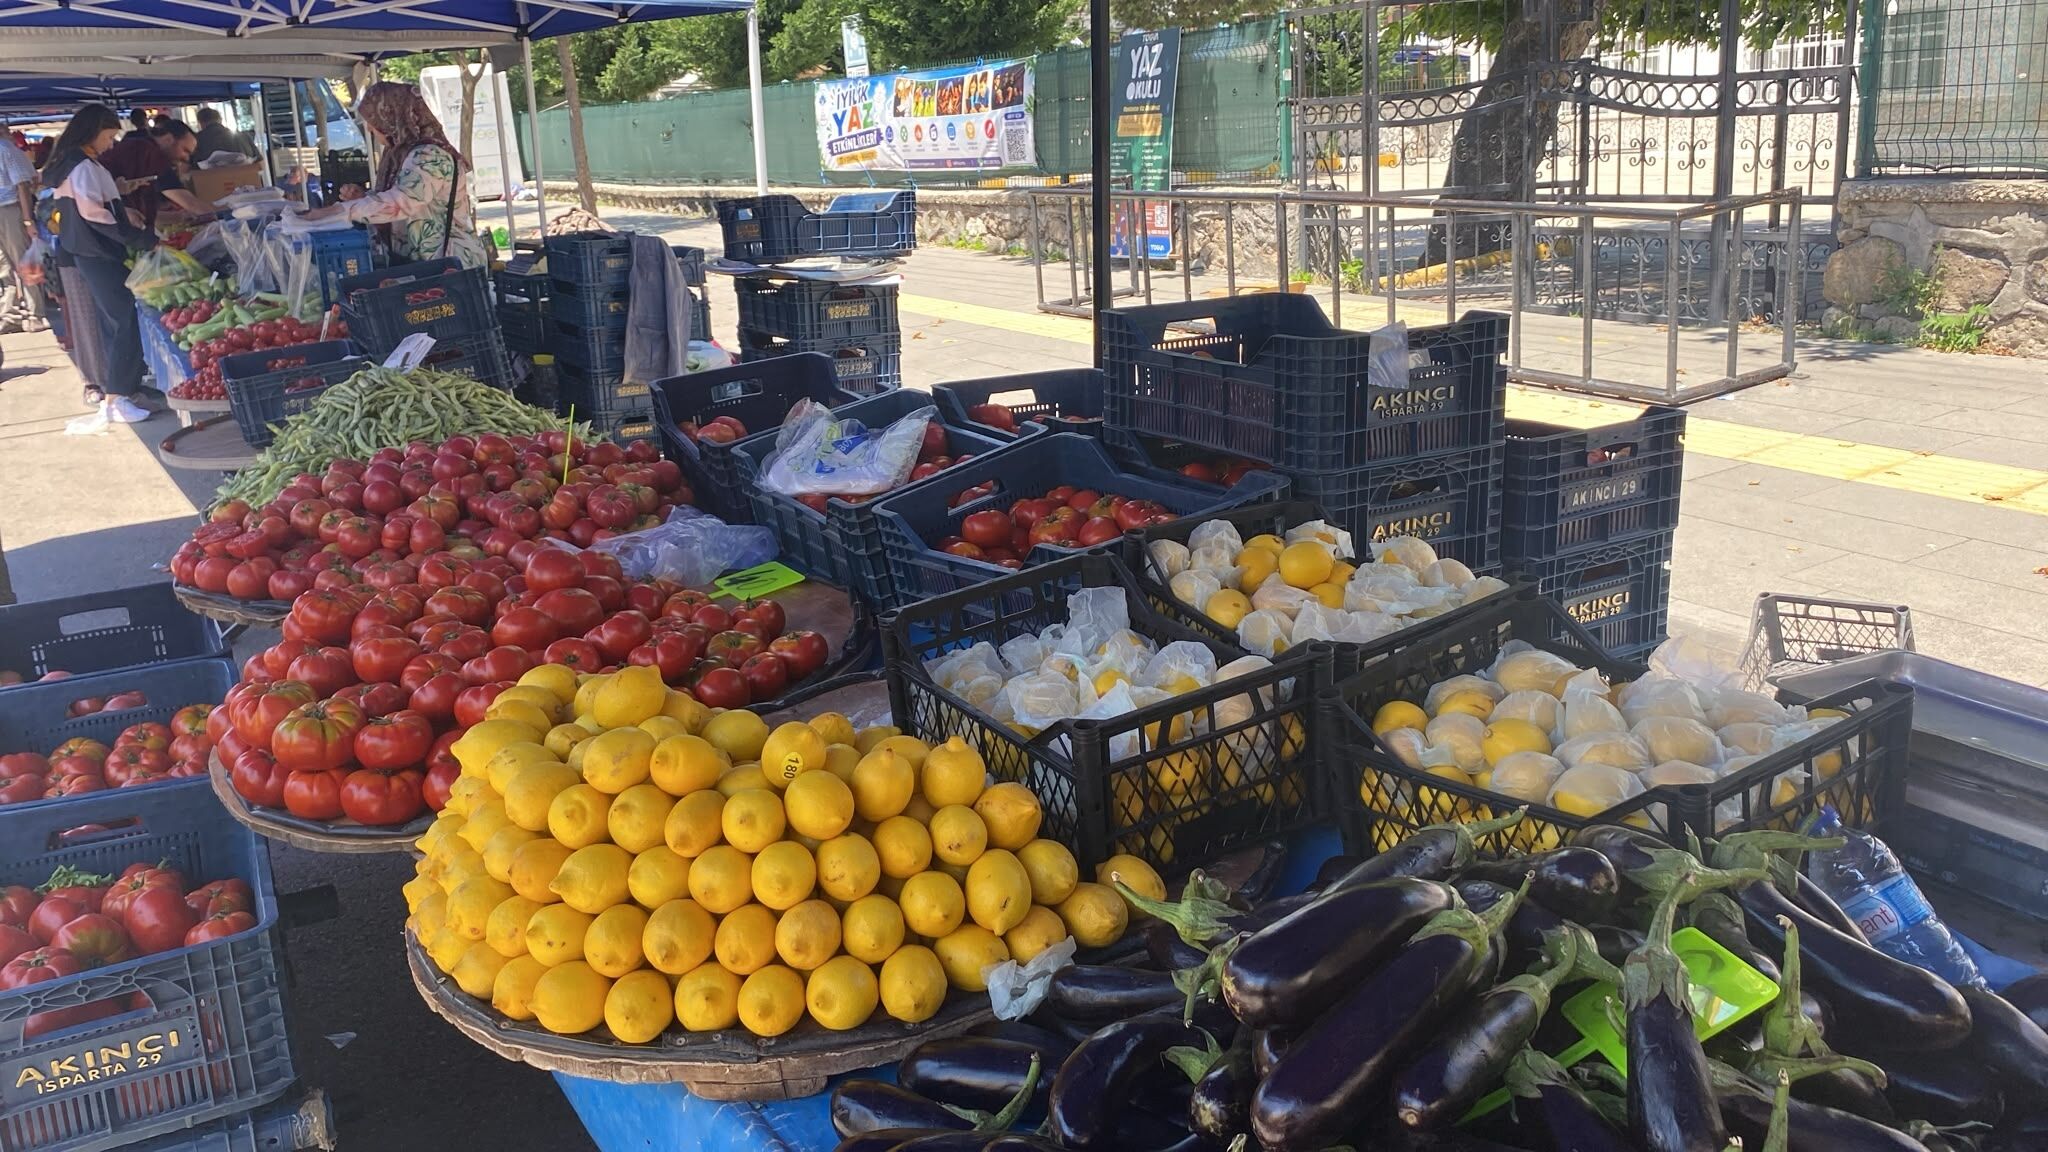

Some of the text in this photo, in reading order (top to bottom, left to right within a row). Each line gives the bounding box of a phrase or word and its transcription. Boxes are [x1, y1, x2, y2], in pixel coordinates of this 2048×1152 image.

[1130, 43, 1164, 79] YAZ
[837, 83, 868, 110] İYİLİK
[1126, 79, 1161, 100] OKULU
[832, 102, 874, 136] YAZ
[832, 130, 878, 154] ETKİNLİKLERİ
[1372, 385, 1455, 411] AKINCI
[1381, 401, 1444, 419] ISPARTA 29
[1572, 480, 1636, 507] AKINCI 29
[1373, 511, 1451, 540] AKINCI
[1426, 527, 1440, 537] 29
[1567, 591, 1630, 618] AKINCI
[1573, 606, 1621, 624] SPARTA 29
[783, 757, 800, 779] 180
[15, 1030, 179, 1088] AKINCI
[37, 1053, 162, 1095] ISPARTA 29
